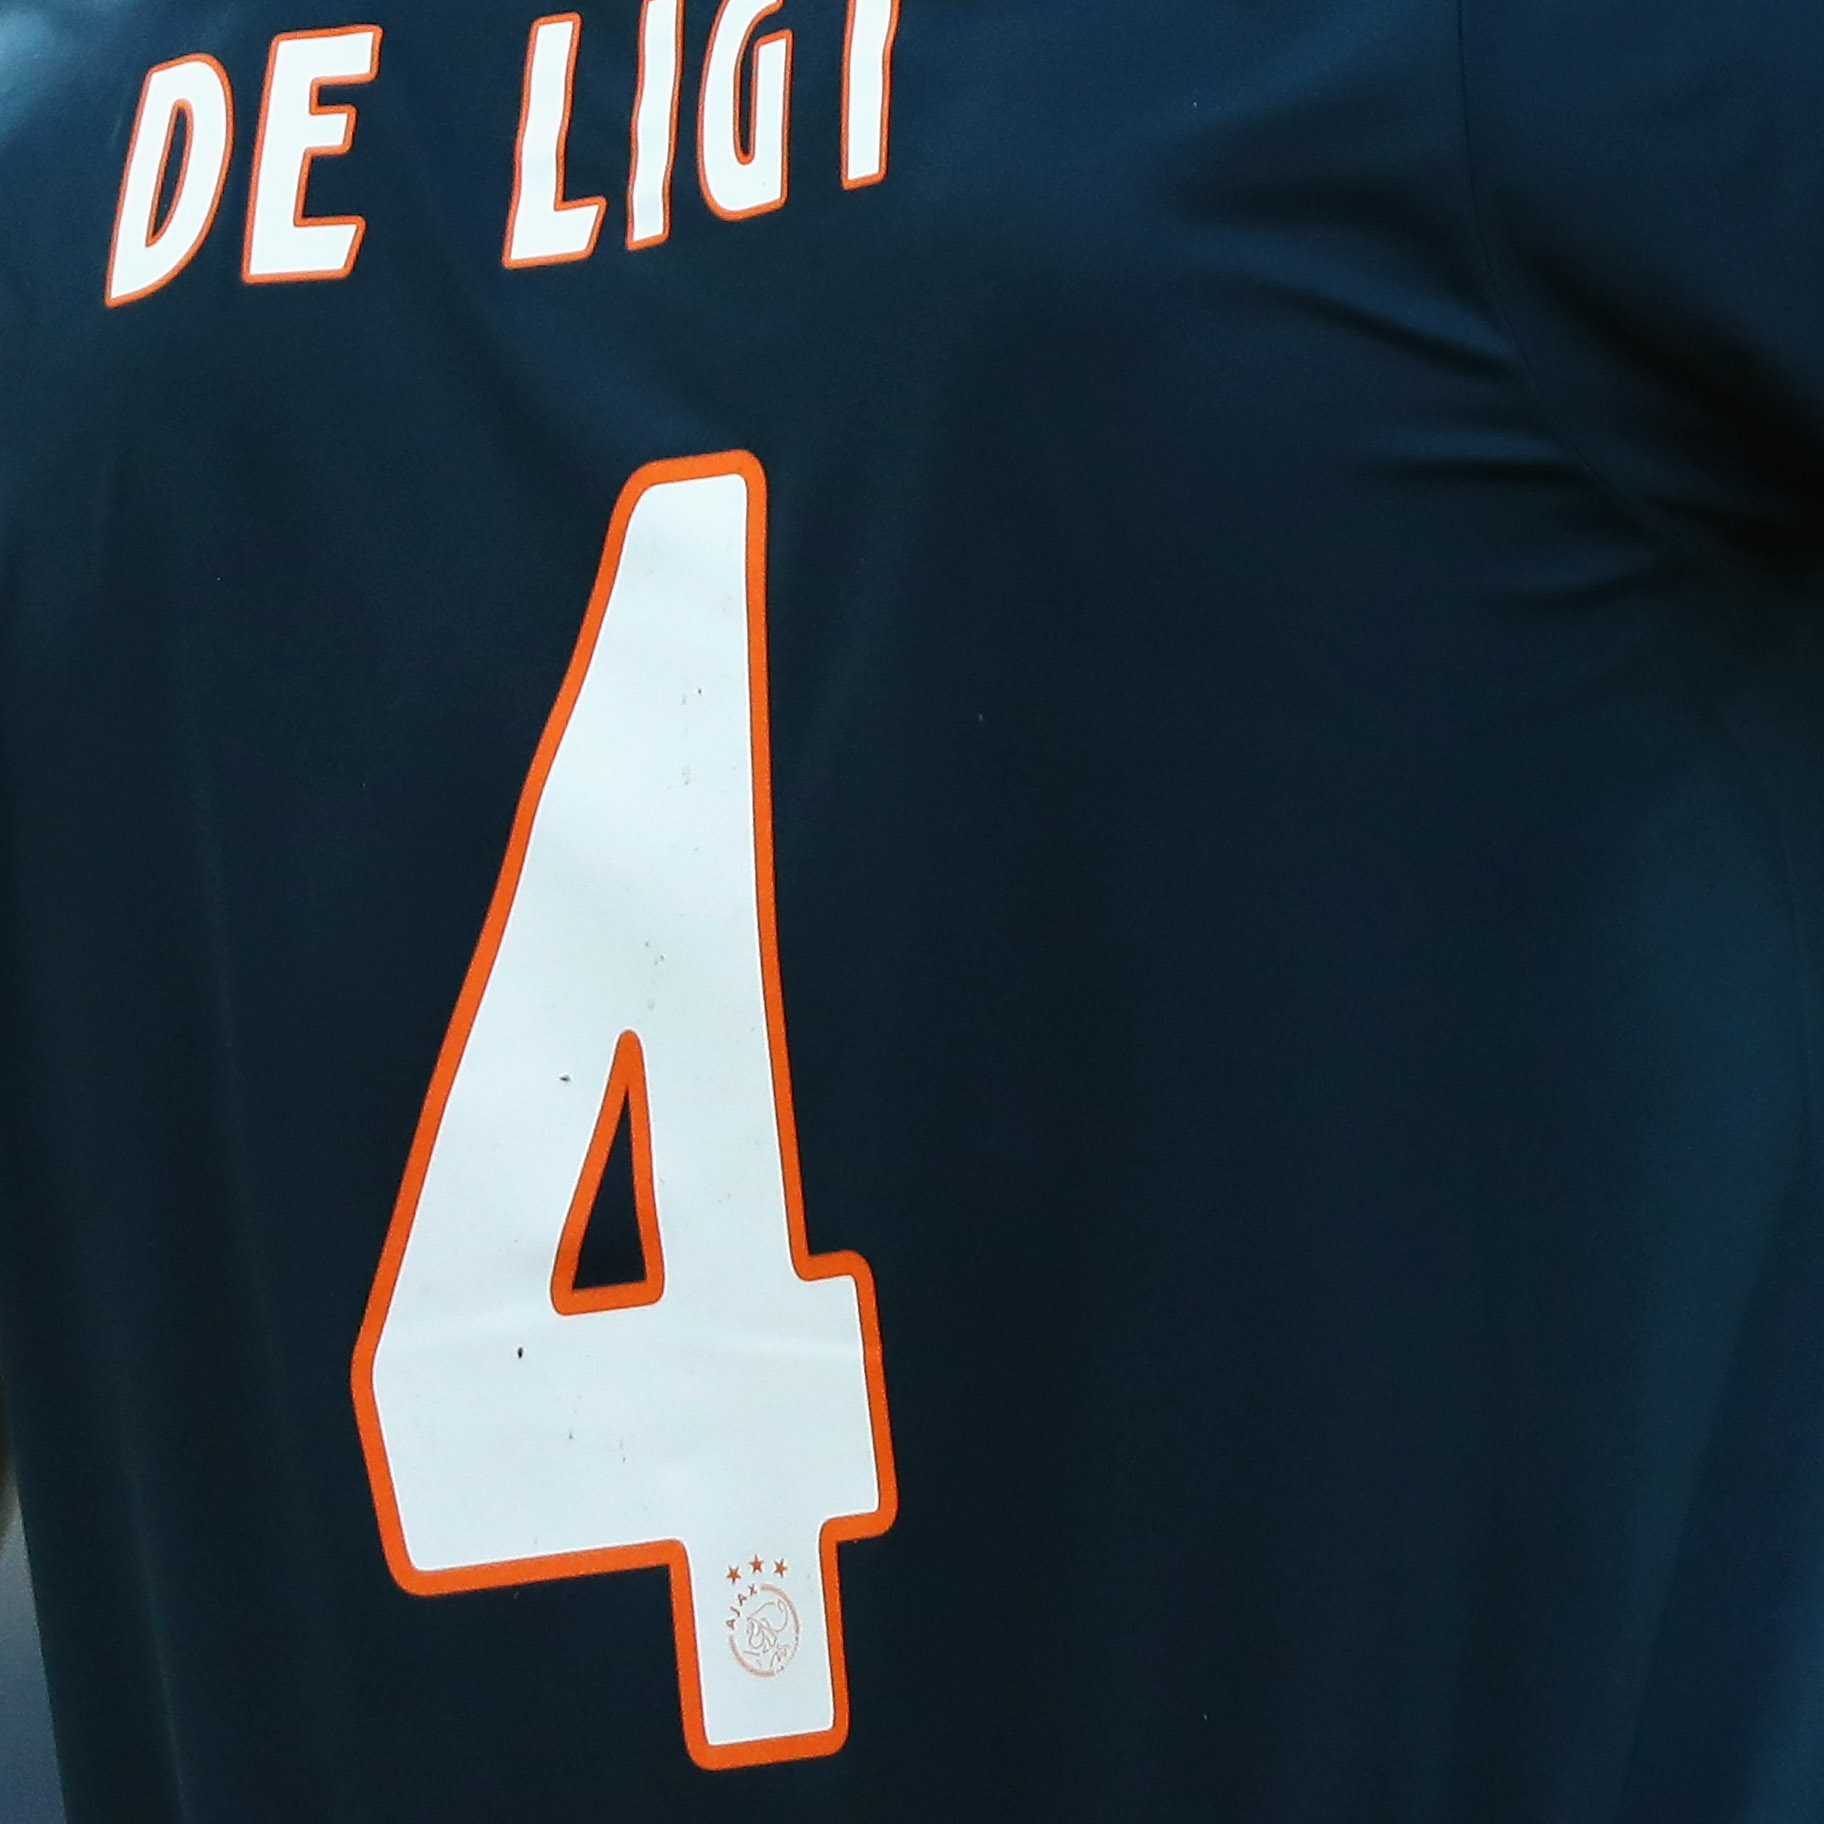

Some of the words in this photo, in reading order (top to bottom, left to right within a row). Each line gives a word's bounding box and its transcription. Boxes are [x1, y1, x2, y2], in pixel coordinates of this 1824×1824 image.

[104, 24, 383, 308] DE
[350, 449, 898, 1771] 4
[725, 1583, 758, 1631] AJAX
